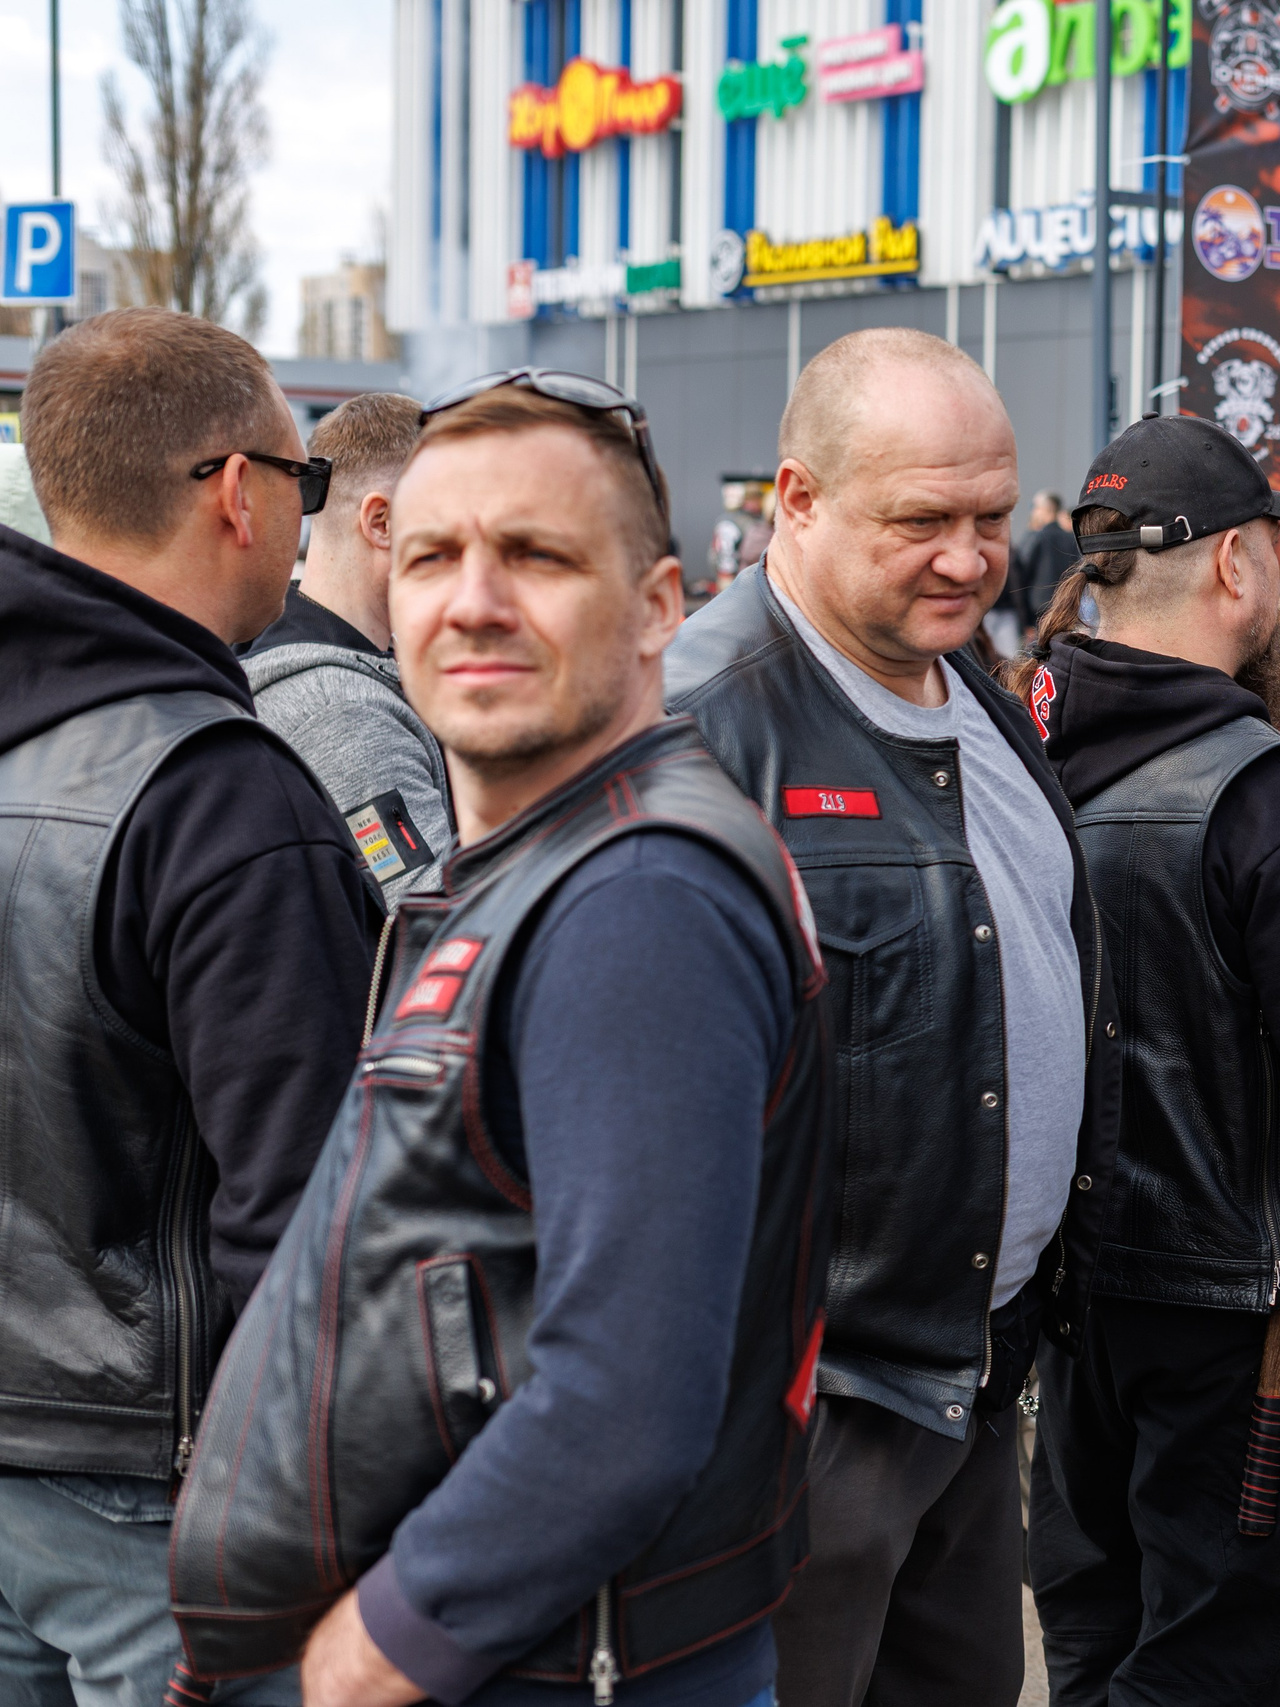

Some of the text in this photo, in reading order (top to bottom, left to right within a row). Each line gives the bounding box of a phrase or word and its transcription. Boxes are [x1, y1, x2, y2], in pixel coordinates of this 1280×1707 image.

[15, 211, 62, 292] P
[818, 793, 846, 812] 219
[357, 817, 372, 829] NEW
[364, 832, 382, 846] YORK
[372, 848, 391, 863] BEST
